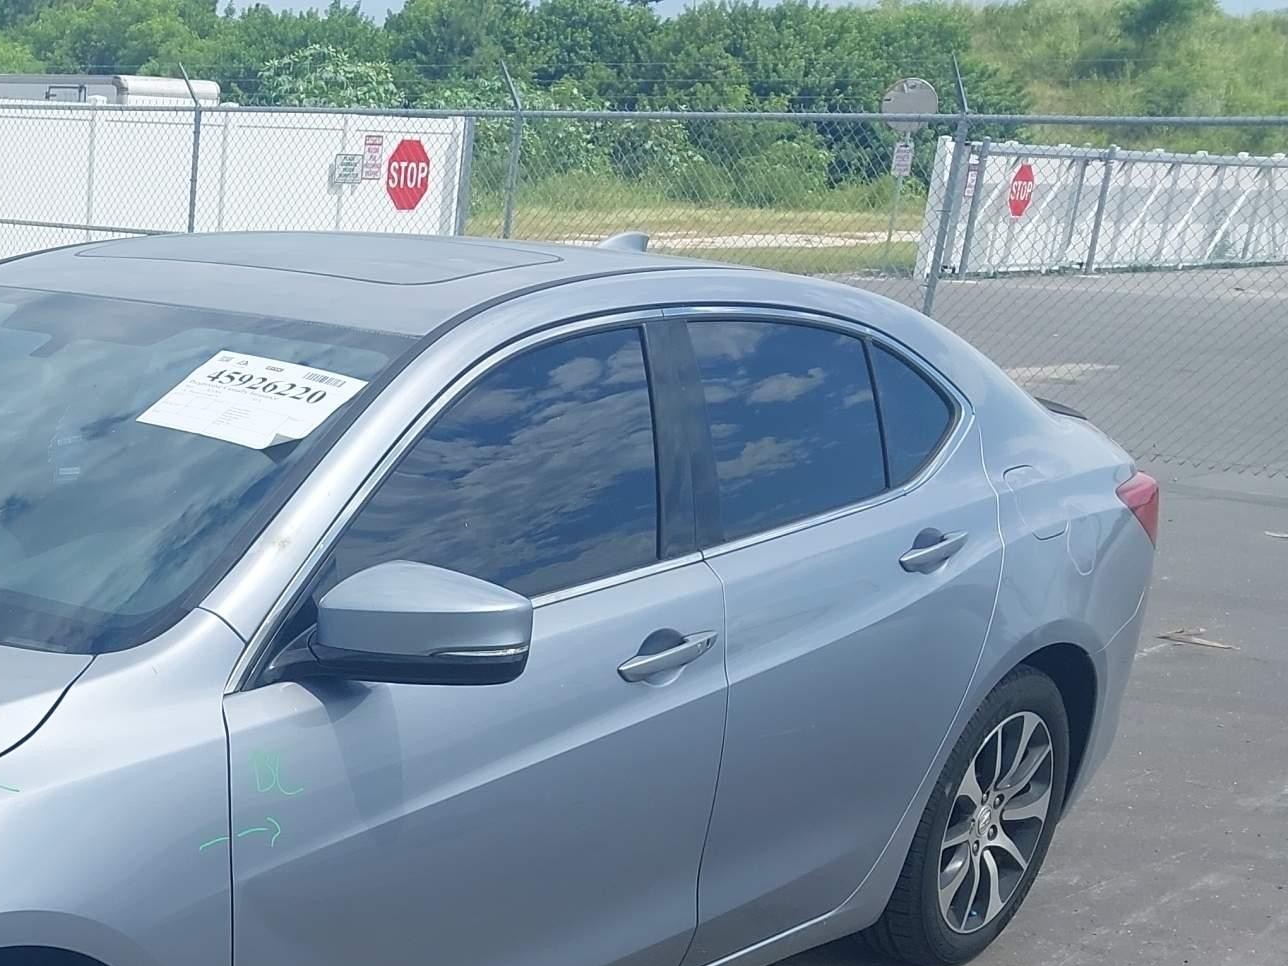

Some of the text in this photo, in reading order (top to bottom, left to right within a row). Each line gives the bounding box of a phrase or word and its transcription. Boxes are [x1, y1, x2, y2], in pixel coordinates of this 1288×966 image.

[388, 161, 428, 189] STOP
[1010, 180, 1033, 200] STOP
[207, 369, 327, 404] 45926220
